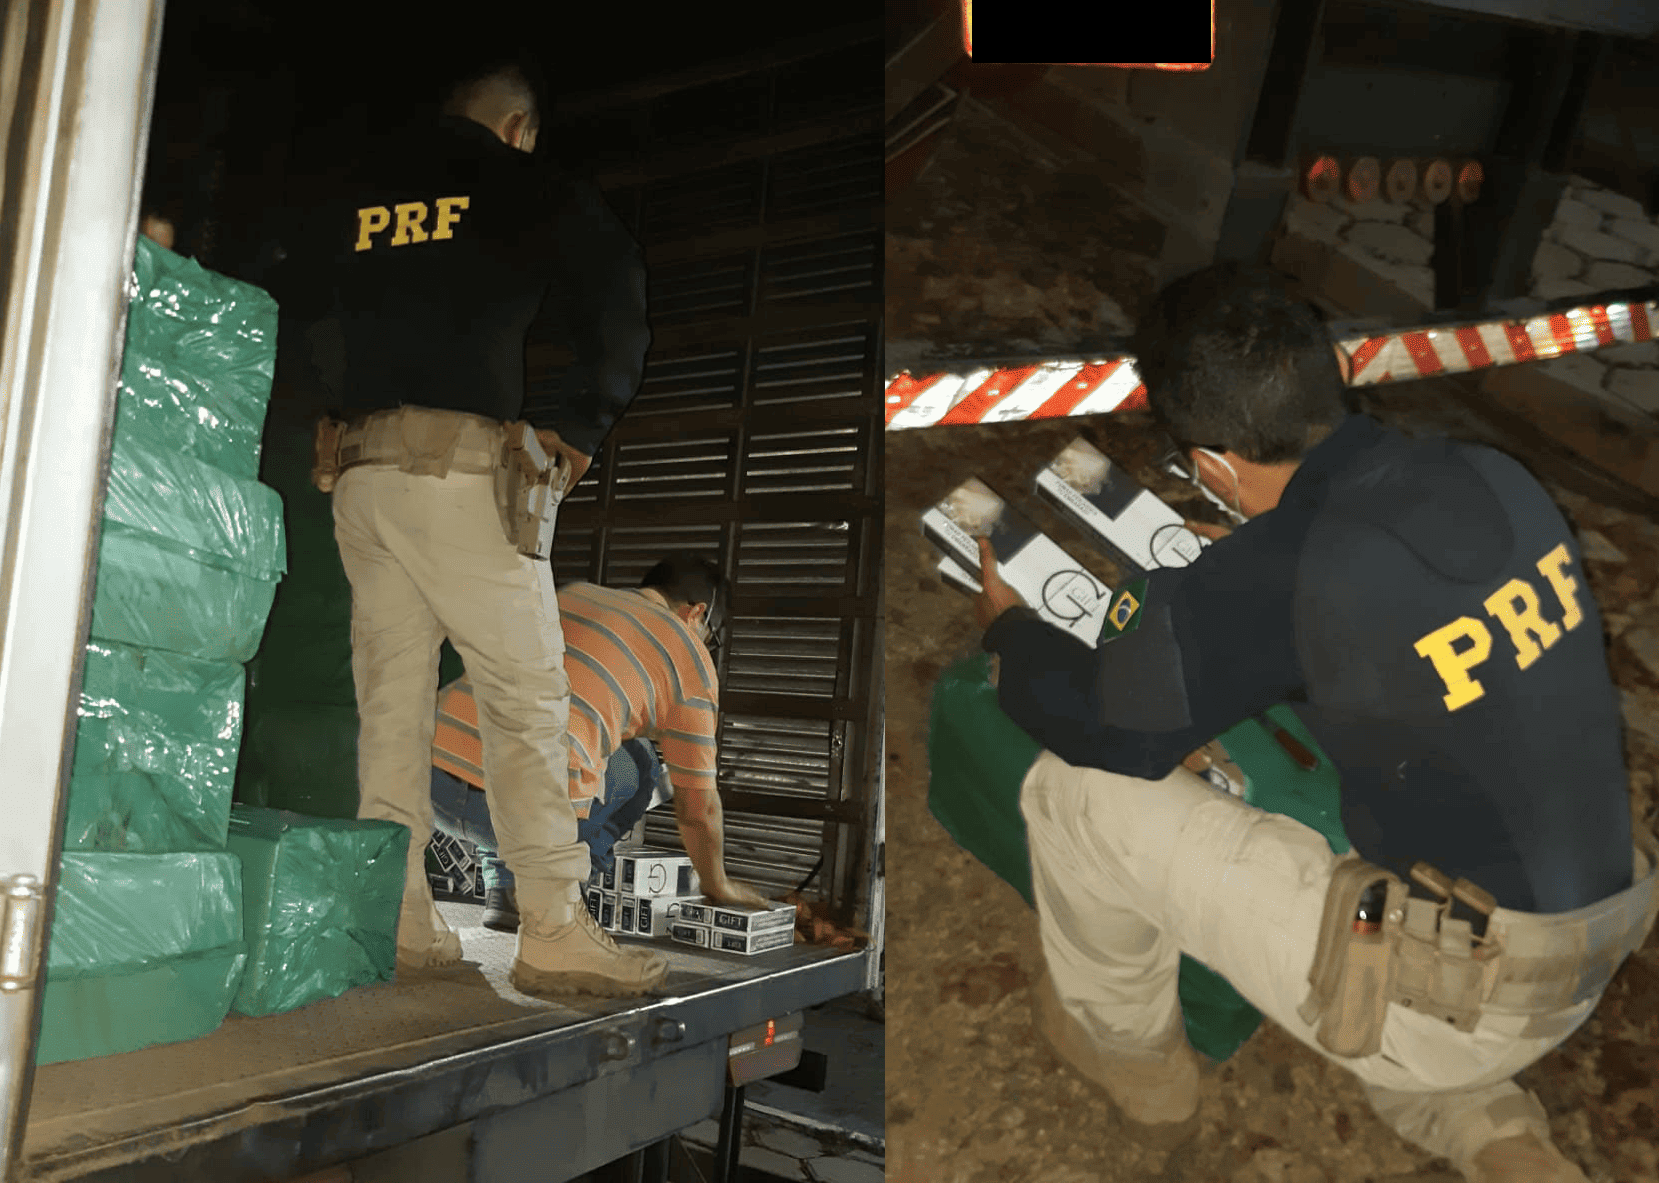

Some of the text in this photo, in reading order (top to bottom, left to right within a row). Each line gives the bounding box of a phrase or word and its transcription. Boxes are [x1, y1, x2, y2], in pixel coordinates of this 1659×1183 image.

[355, 196, 470, 251] PRF
[1413, 543, 1584, 712] PRF
[640, 905, 649, 929] GIFT
[718, 913, 743, 928] GIFT
